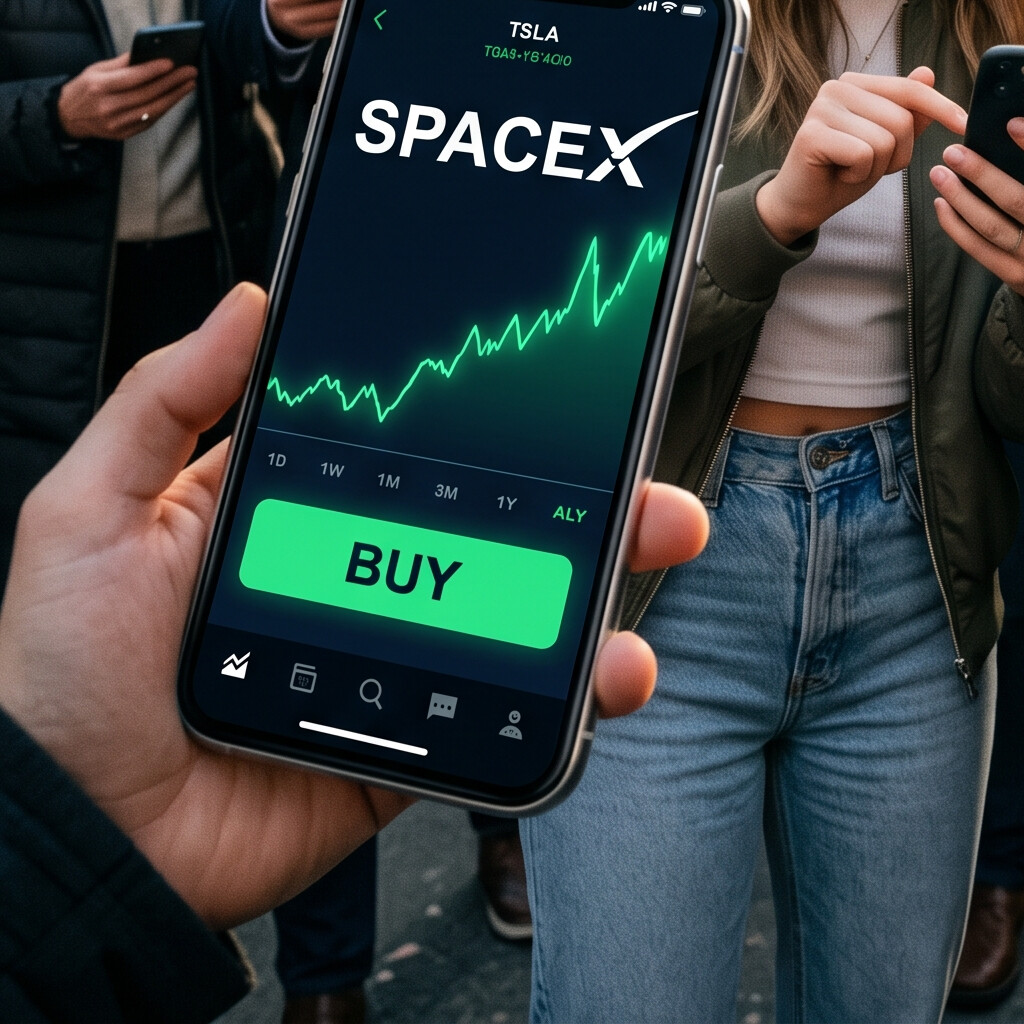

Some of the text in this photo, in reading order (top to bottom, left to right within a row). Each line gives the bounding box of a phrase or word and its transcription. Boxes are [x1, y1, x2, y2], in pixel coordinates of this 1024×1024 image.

[509, 20, 559, 43] TSLA
[355, 99, 699, 189] SPACEX
[268, 452, 288, 468] 1D
[320, 462, 345, 478] 1W
[377, 473, 401, 490] 1M
[434, 483, 459, 501] 3M
[497, 495, 518, 512] 1Y
[552, 505, 588, 524] ALY
[344, 541, 464, 602] BUY
